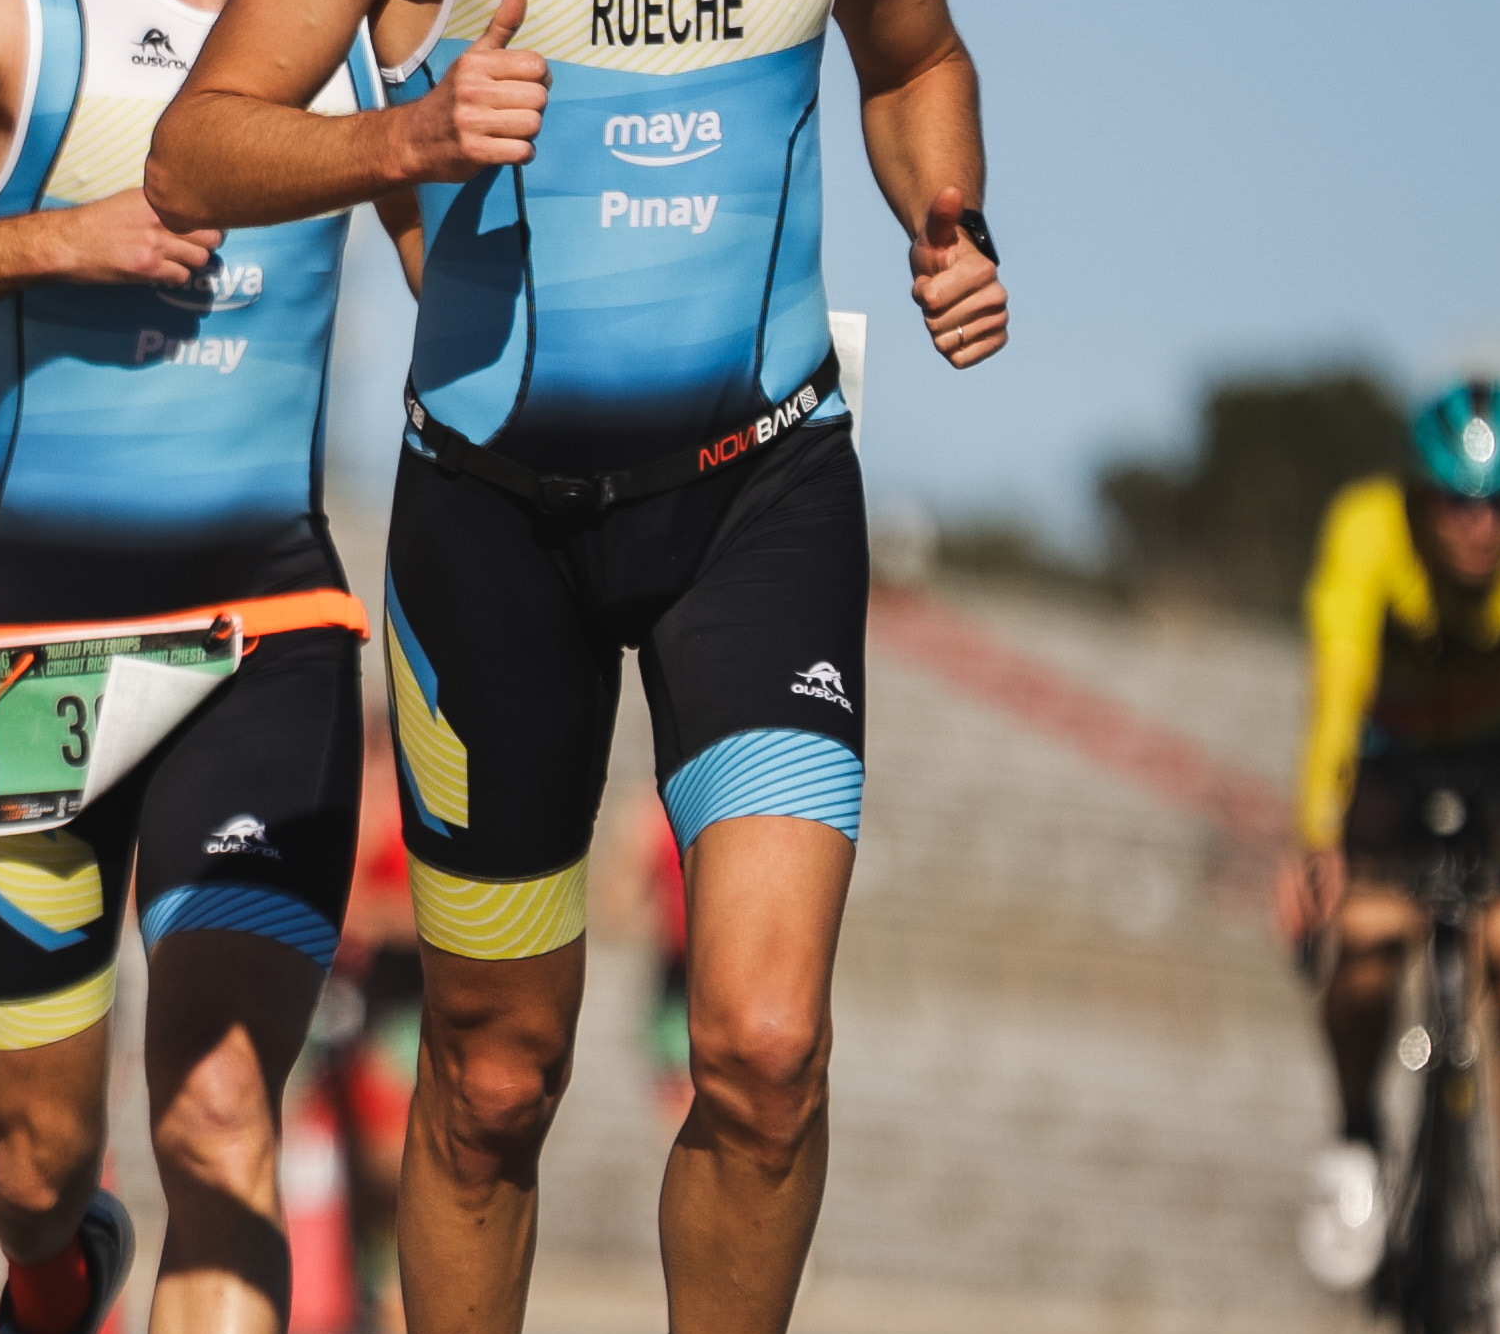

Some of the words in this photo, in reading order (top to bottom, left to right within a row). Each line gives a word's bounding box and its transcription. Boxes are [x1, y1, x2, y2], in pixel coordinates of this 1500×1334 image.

[604, 110, 723, 152] maya
[83, 639, 102, 656] PER
[103, 637, 141, 654] EQUIPS
[46, 657, 85, 676] CIRCUIT
[56, 694, 105, 768] 3
